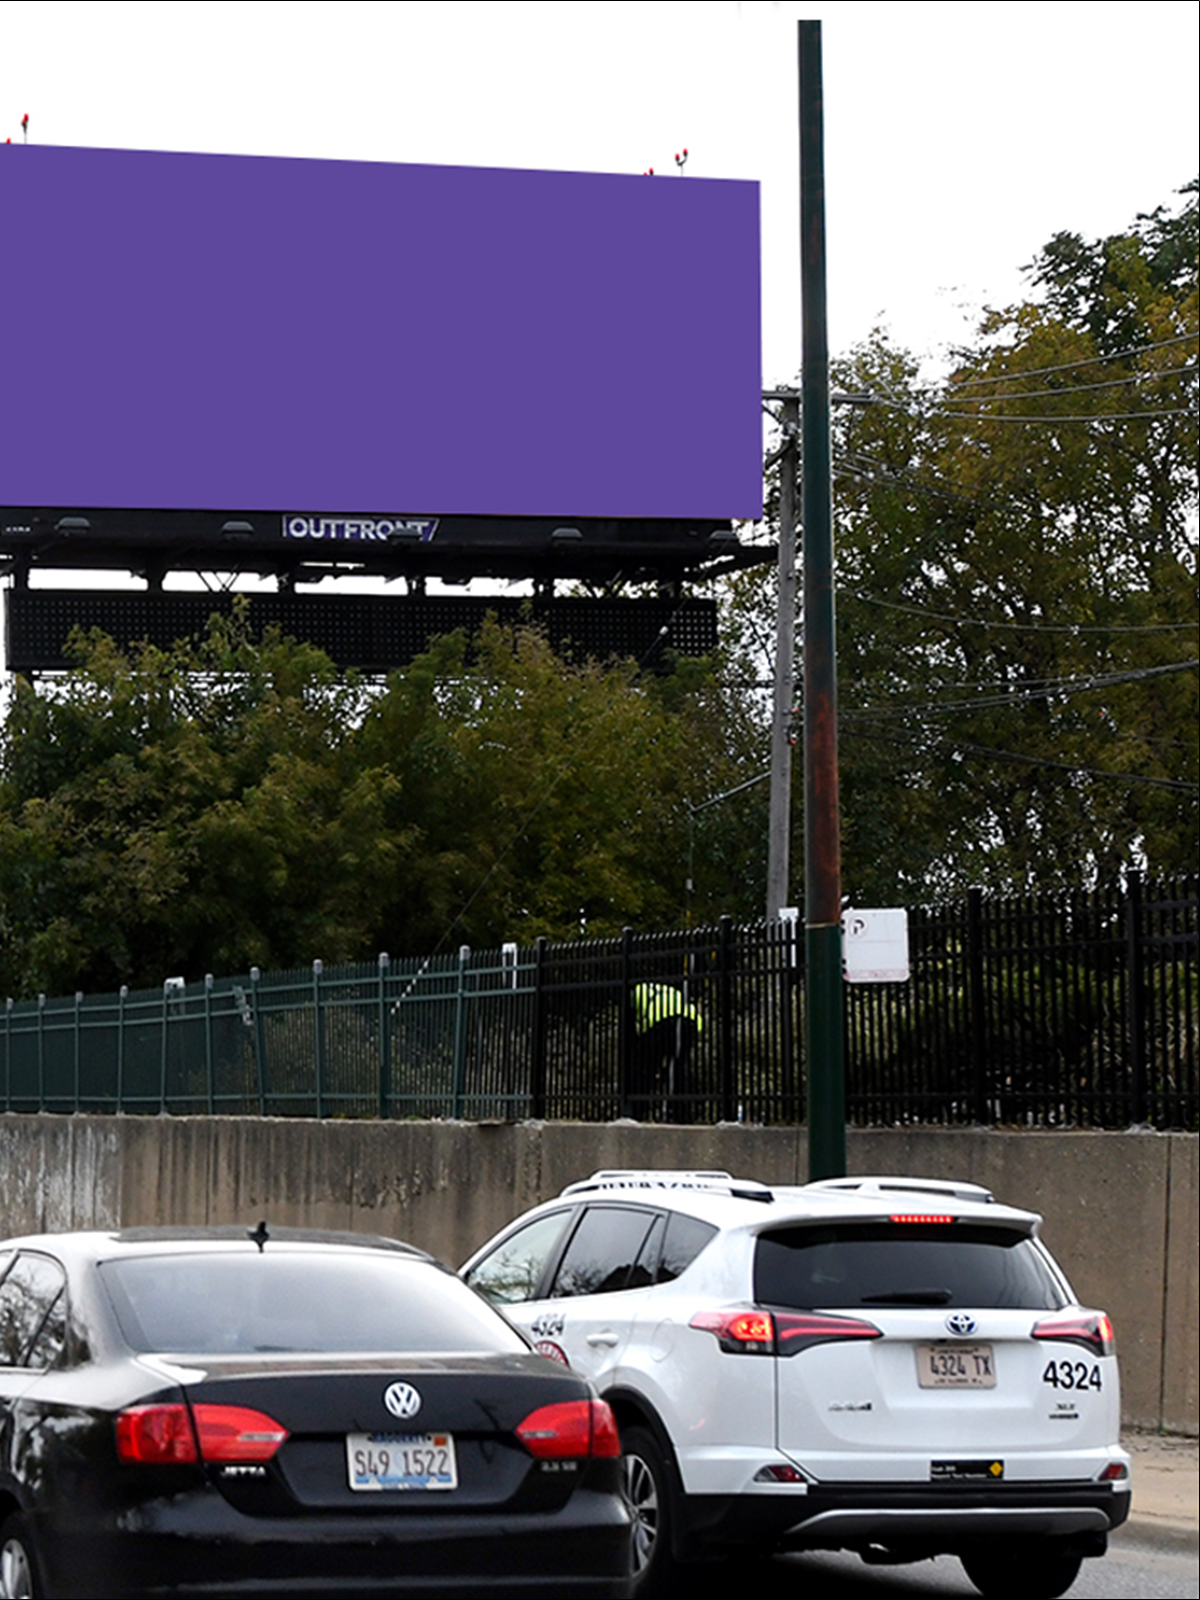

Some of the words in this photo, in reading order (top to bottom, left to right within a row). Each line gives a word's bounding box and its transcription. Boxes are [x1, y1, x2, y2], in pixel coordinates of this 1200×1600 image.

[929, 1355, 966, 1376] 4324
[973, 1355, 991, 1376] TX
[1042, 1360, 1102, 1392] 4324
[402, 1449, 448, 1476] 1522
